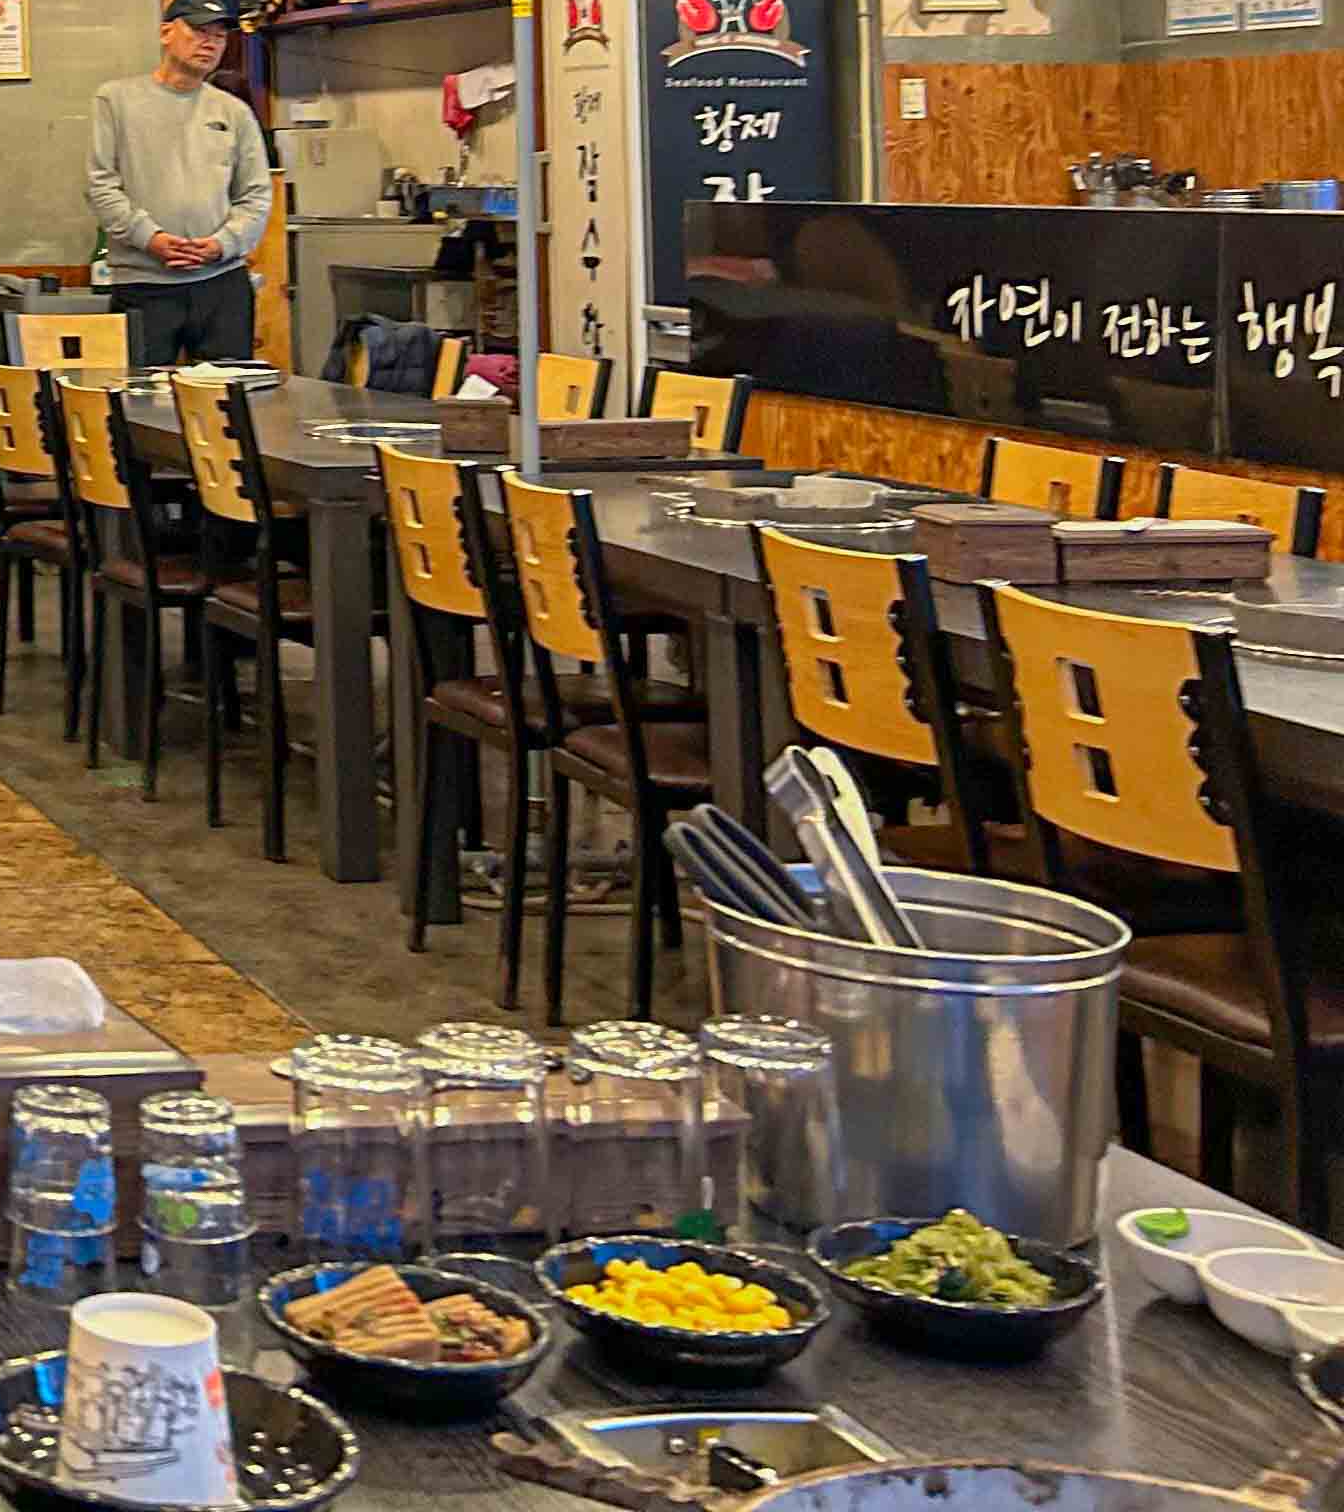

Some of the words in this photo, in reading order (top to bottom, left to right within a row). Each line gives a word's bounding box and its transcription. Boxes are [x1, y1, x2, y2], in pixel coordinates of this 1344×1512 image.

[663, 77, 724, 89] Seafood
[728, 77, 809, 88] Restaurant
[693, 102, 782, 153] 황제
[946, 273, 1084, 348] 자연이
[1100, 296, 1213, 365] 전하는
[1236, 280, 1344, 399] 행복
